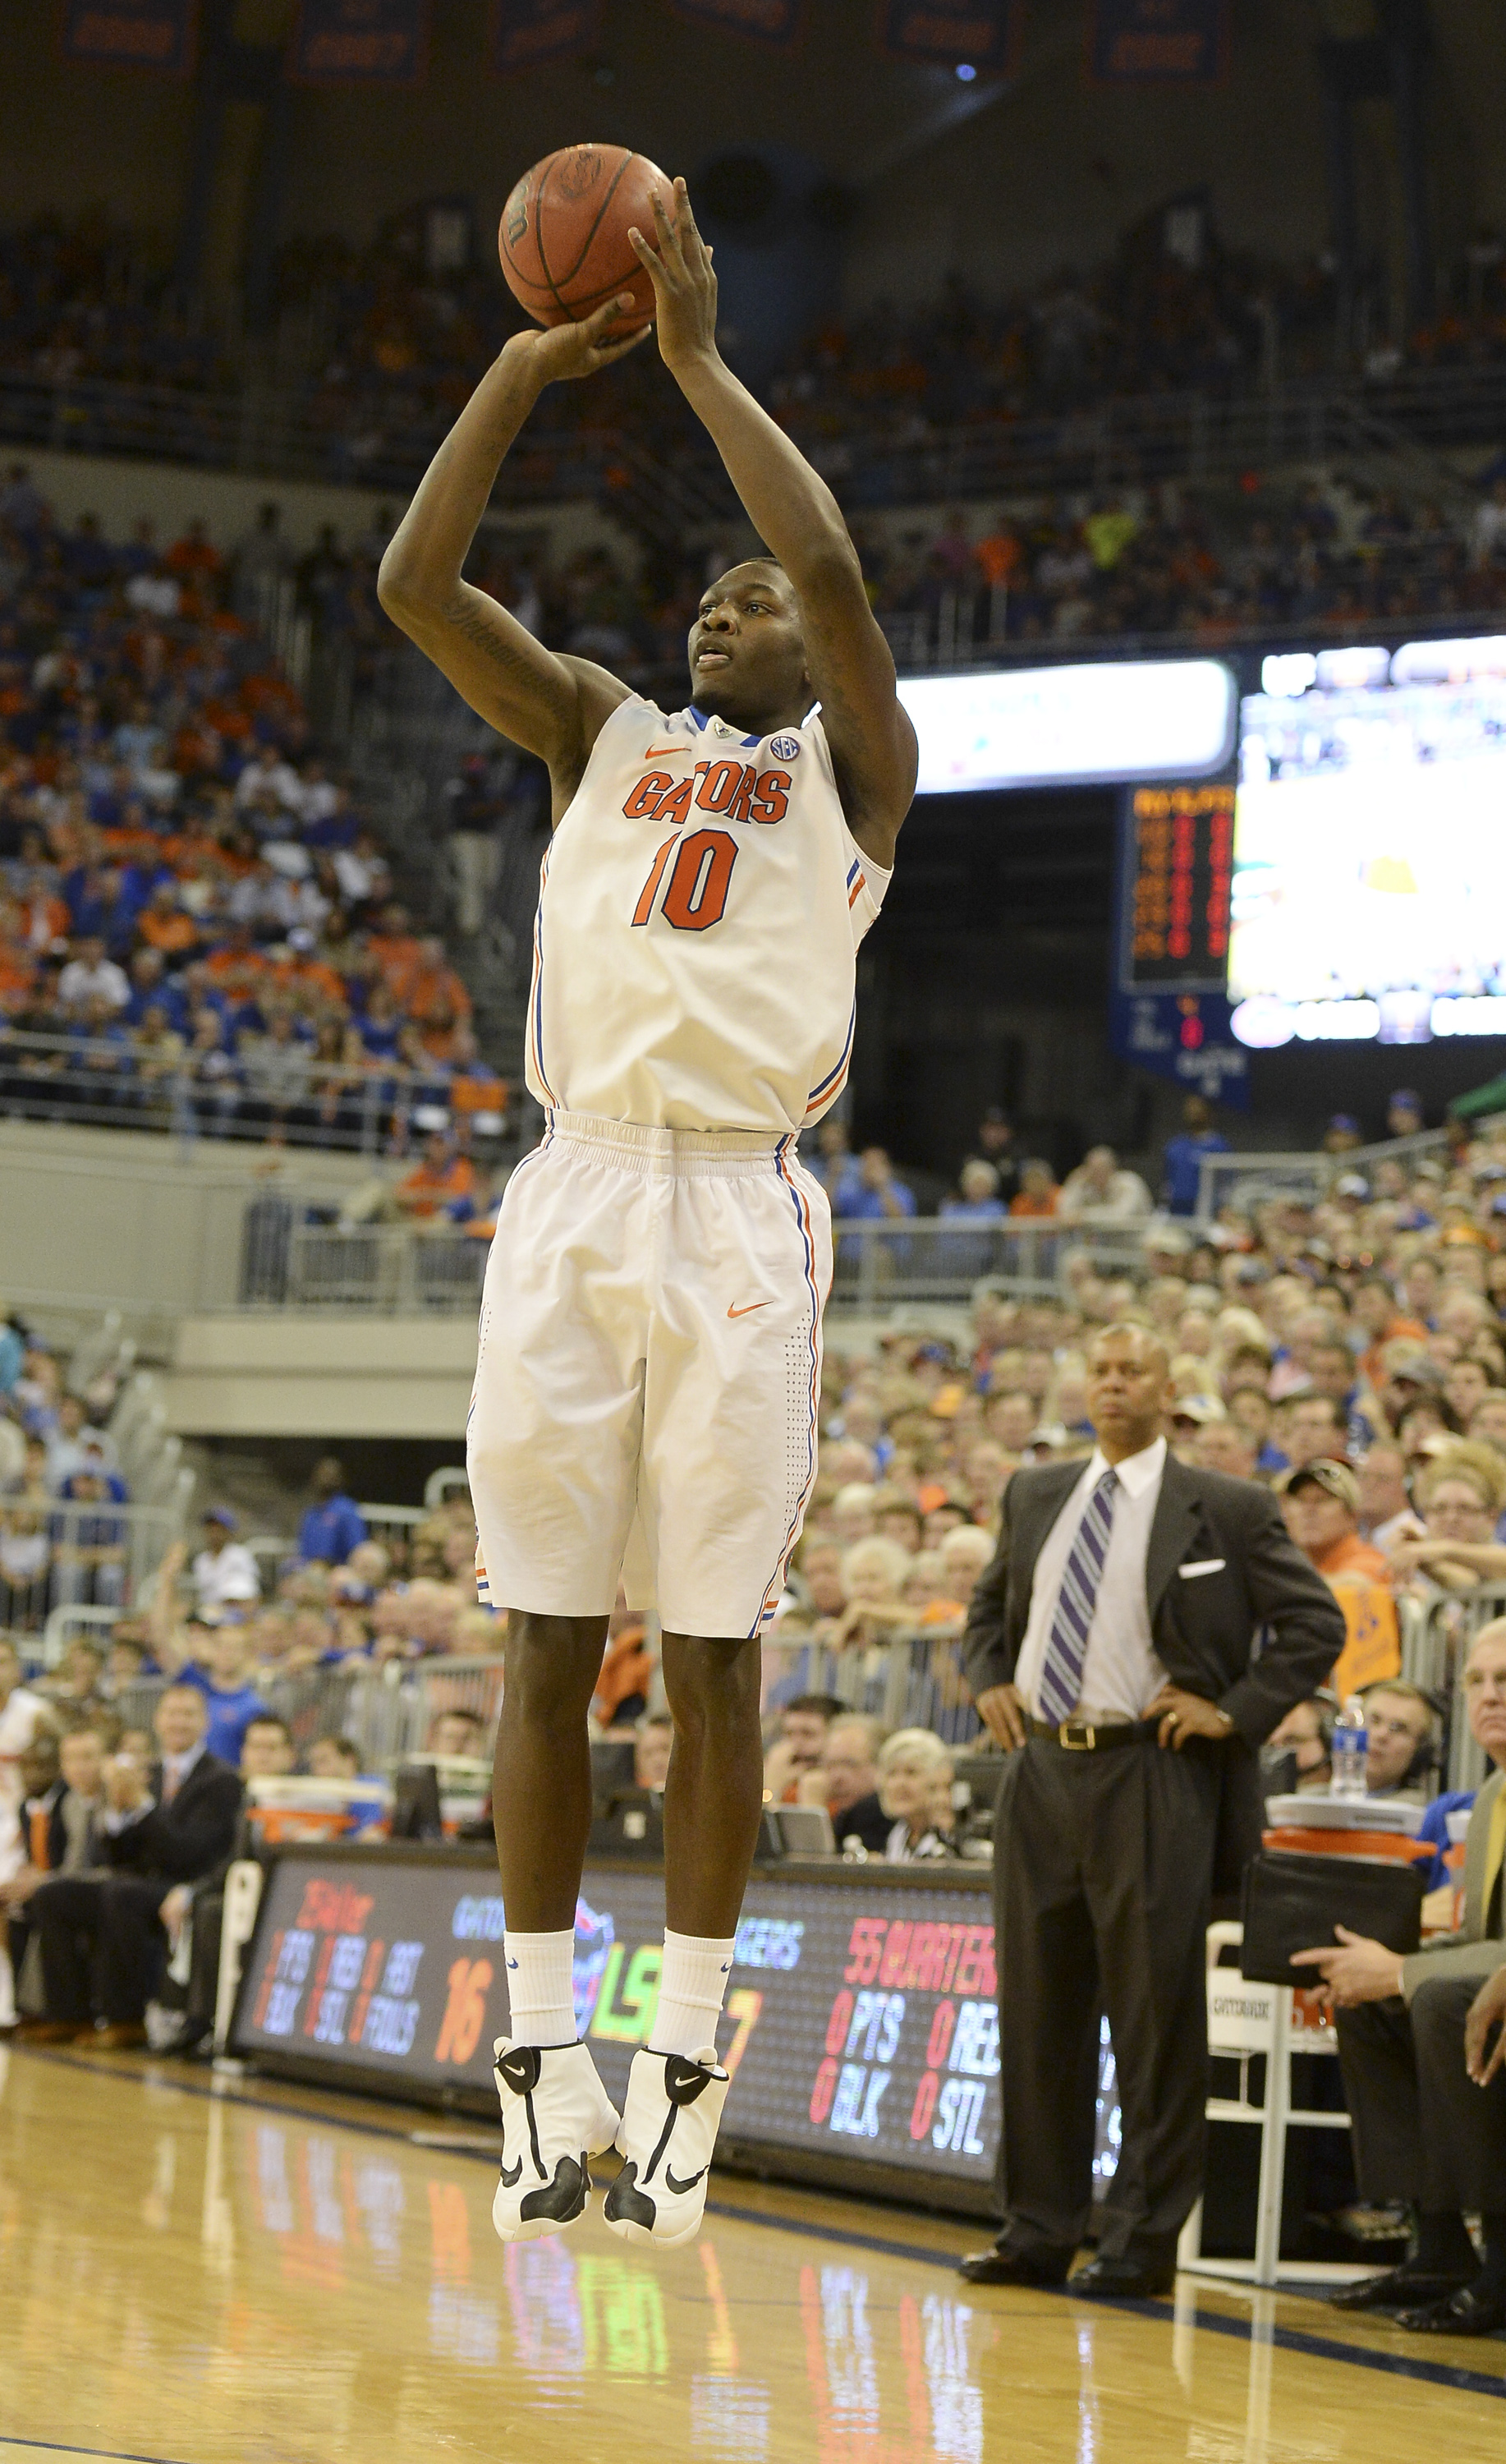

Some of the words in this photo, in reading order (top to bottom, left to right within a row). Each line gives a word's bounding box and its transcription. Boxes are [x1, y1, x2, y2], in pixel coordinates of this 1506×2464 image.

[622, 761, 792, 824] GATORS
[772, 737, 800, 761] SEC
[631, 829, 739, 931] 10
[434, 1956, 493, 2065] 16
[590, 1942, 663, 2045] LS
[845, 1990, 906, 2062] PTS
[829, 2063, 892, 2137] BLK
[932, 2078, 985, 2154] STL
